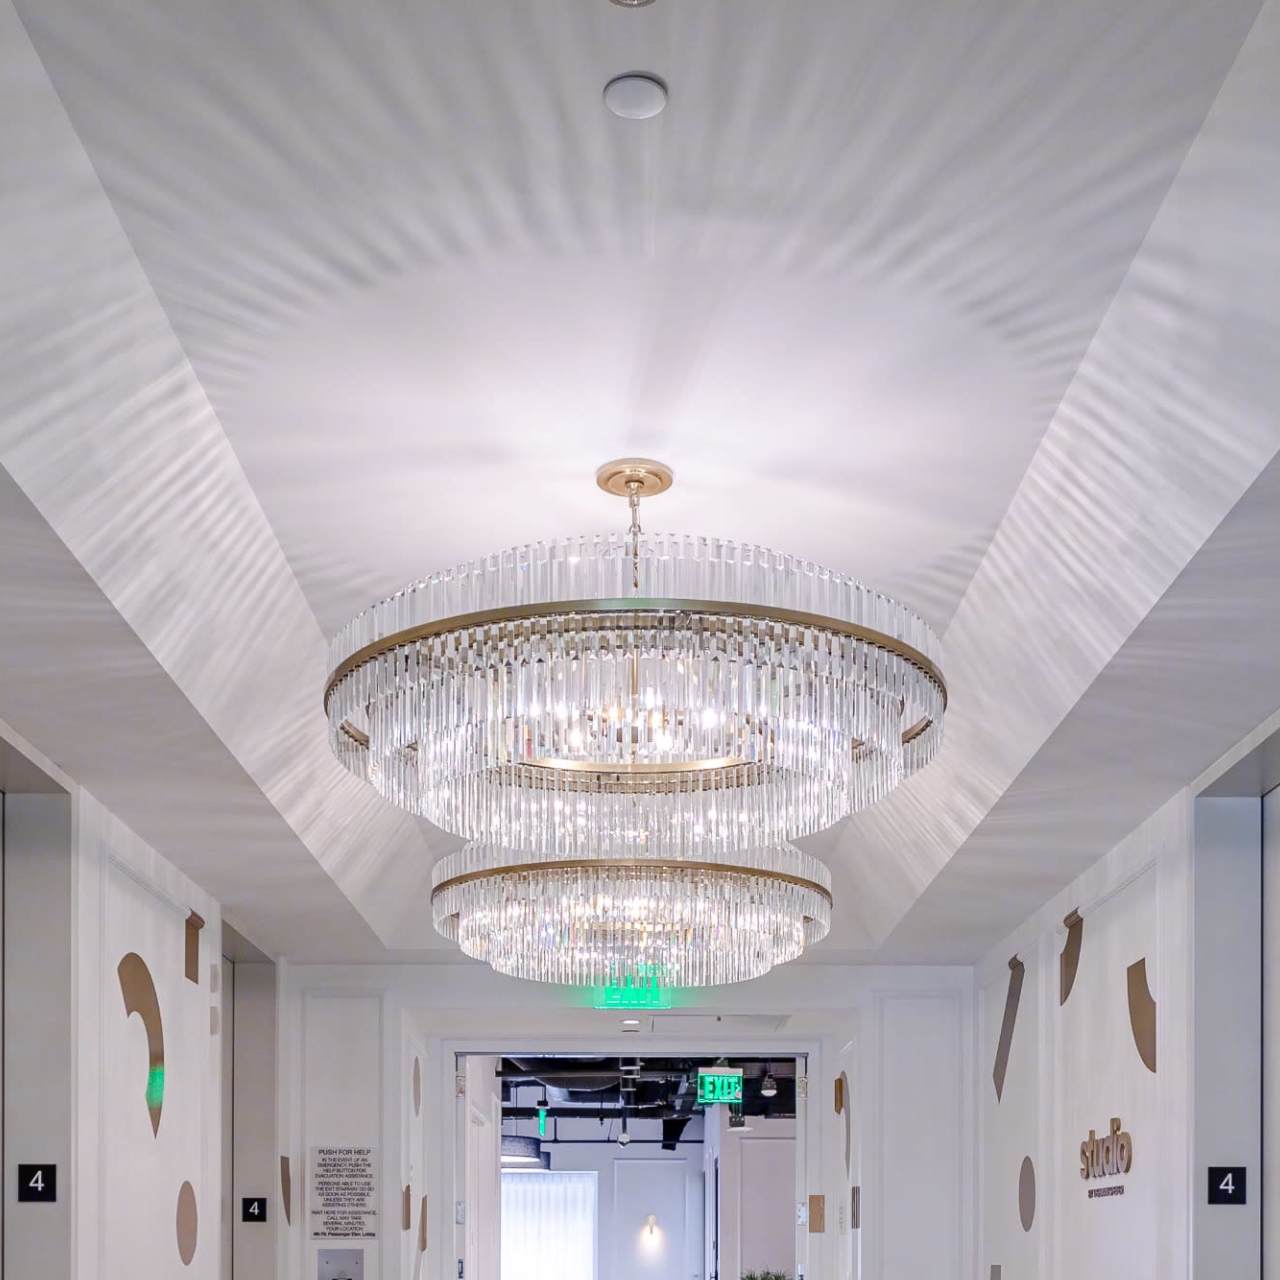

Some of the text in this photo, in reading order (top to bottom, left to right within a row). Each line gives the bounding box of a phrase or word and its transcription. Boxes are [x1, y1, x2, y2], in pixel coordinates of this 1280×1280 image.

[704, 1075, 737, 1098] EXIT
[1080, 1117, 1133, 1181] studio
[29, 1170, 44, 1192] 4
[1219, 1173, 1235, 1194] 4
[249, 1201, 260, 1216] 4
